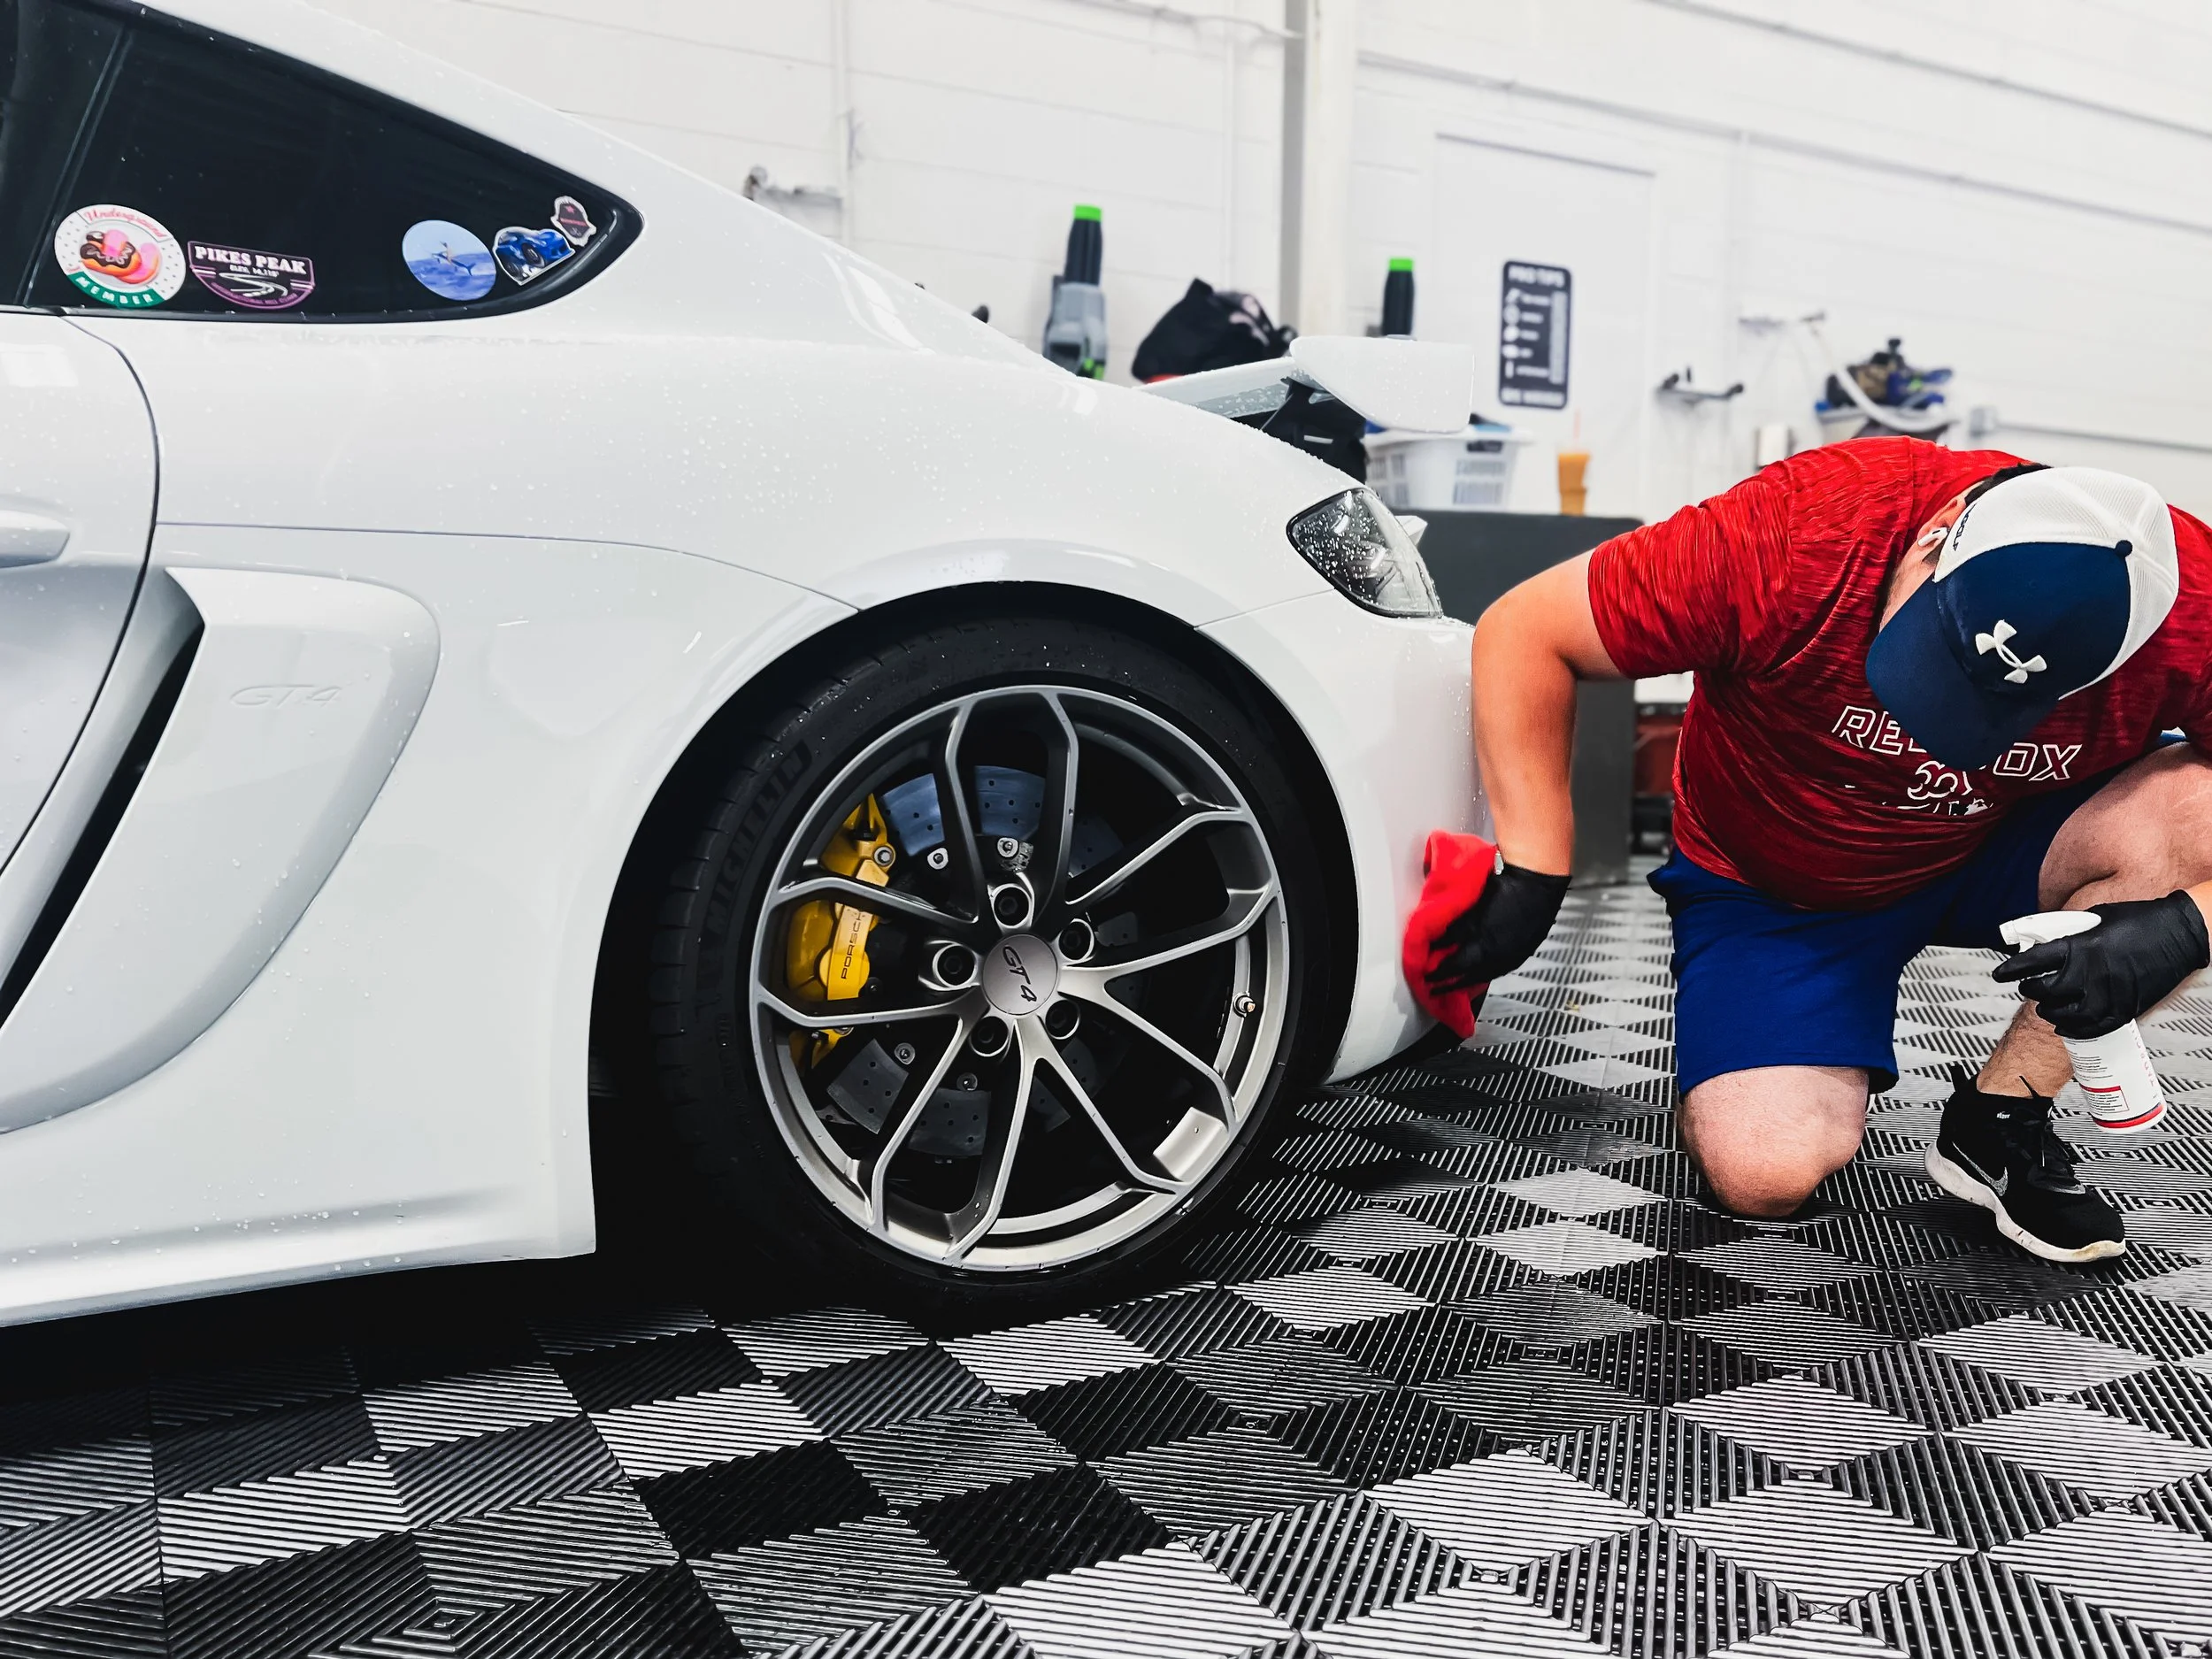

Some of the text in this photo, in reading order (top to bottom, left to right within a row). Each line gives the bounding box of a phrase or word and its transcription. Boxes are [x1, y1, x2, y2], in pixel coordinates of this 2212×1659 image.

[195, 245, 307, 275] PIKES PEAK
[75, 276, 153, 304] MEMBER
[228, 683, 342, 709] GT4
[1832, 705, 1927, 755] RE
[1979, 741, 2083, 781] OX
[704, 749, 807, 935] MICHELIN
[841, 911, 862, 979] PORSCH
